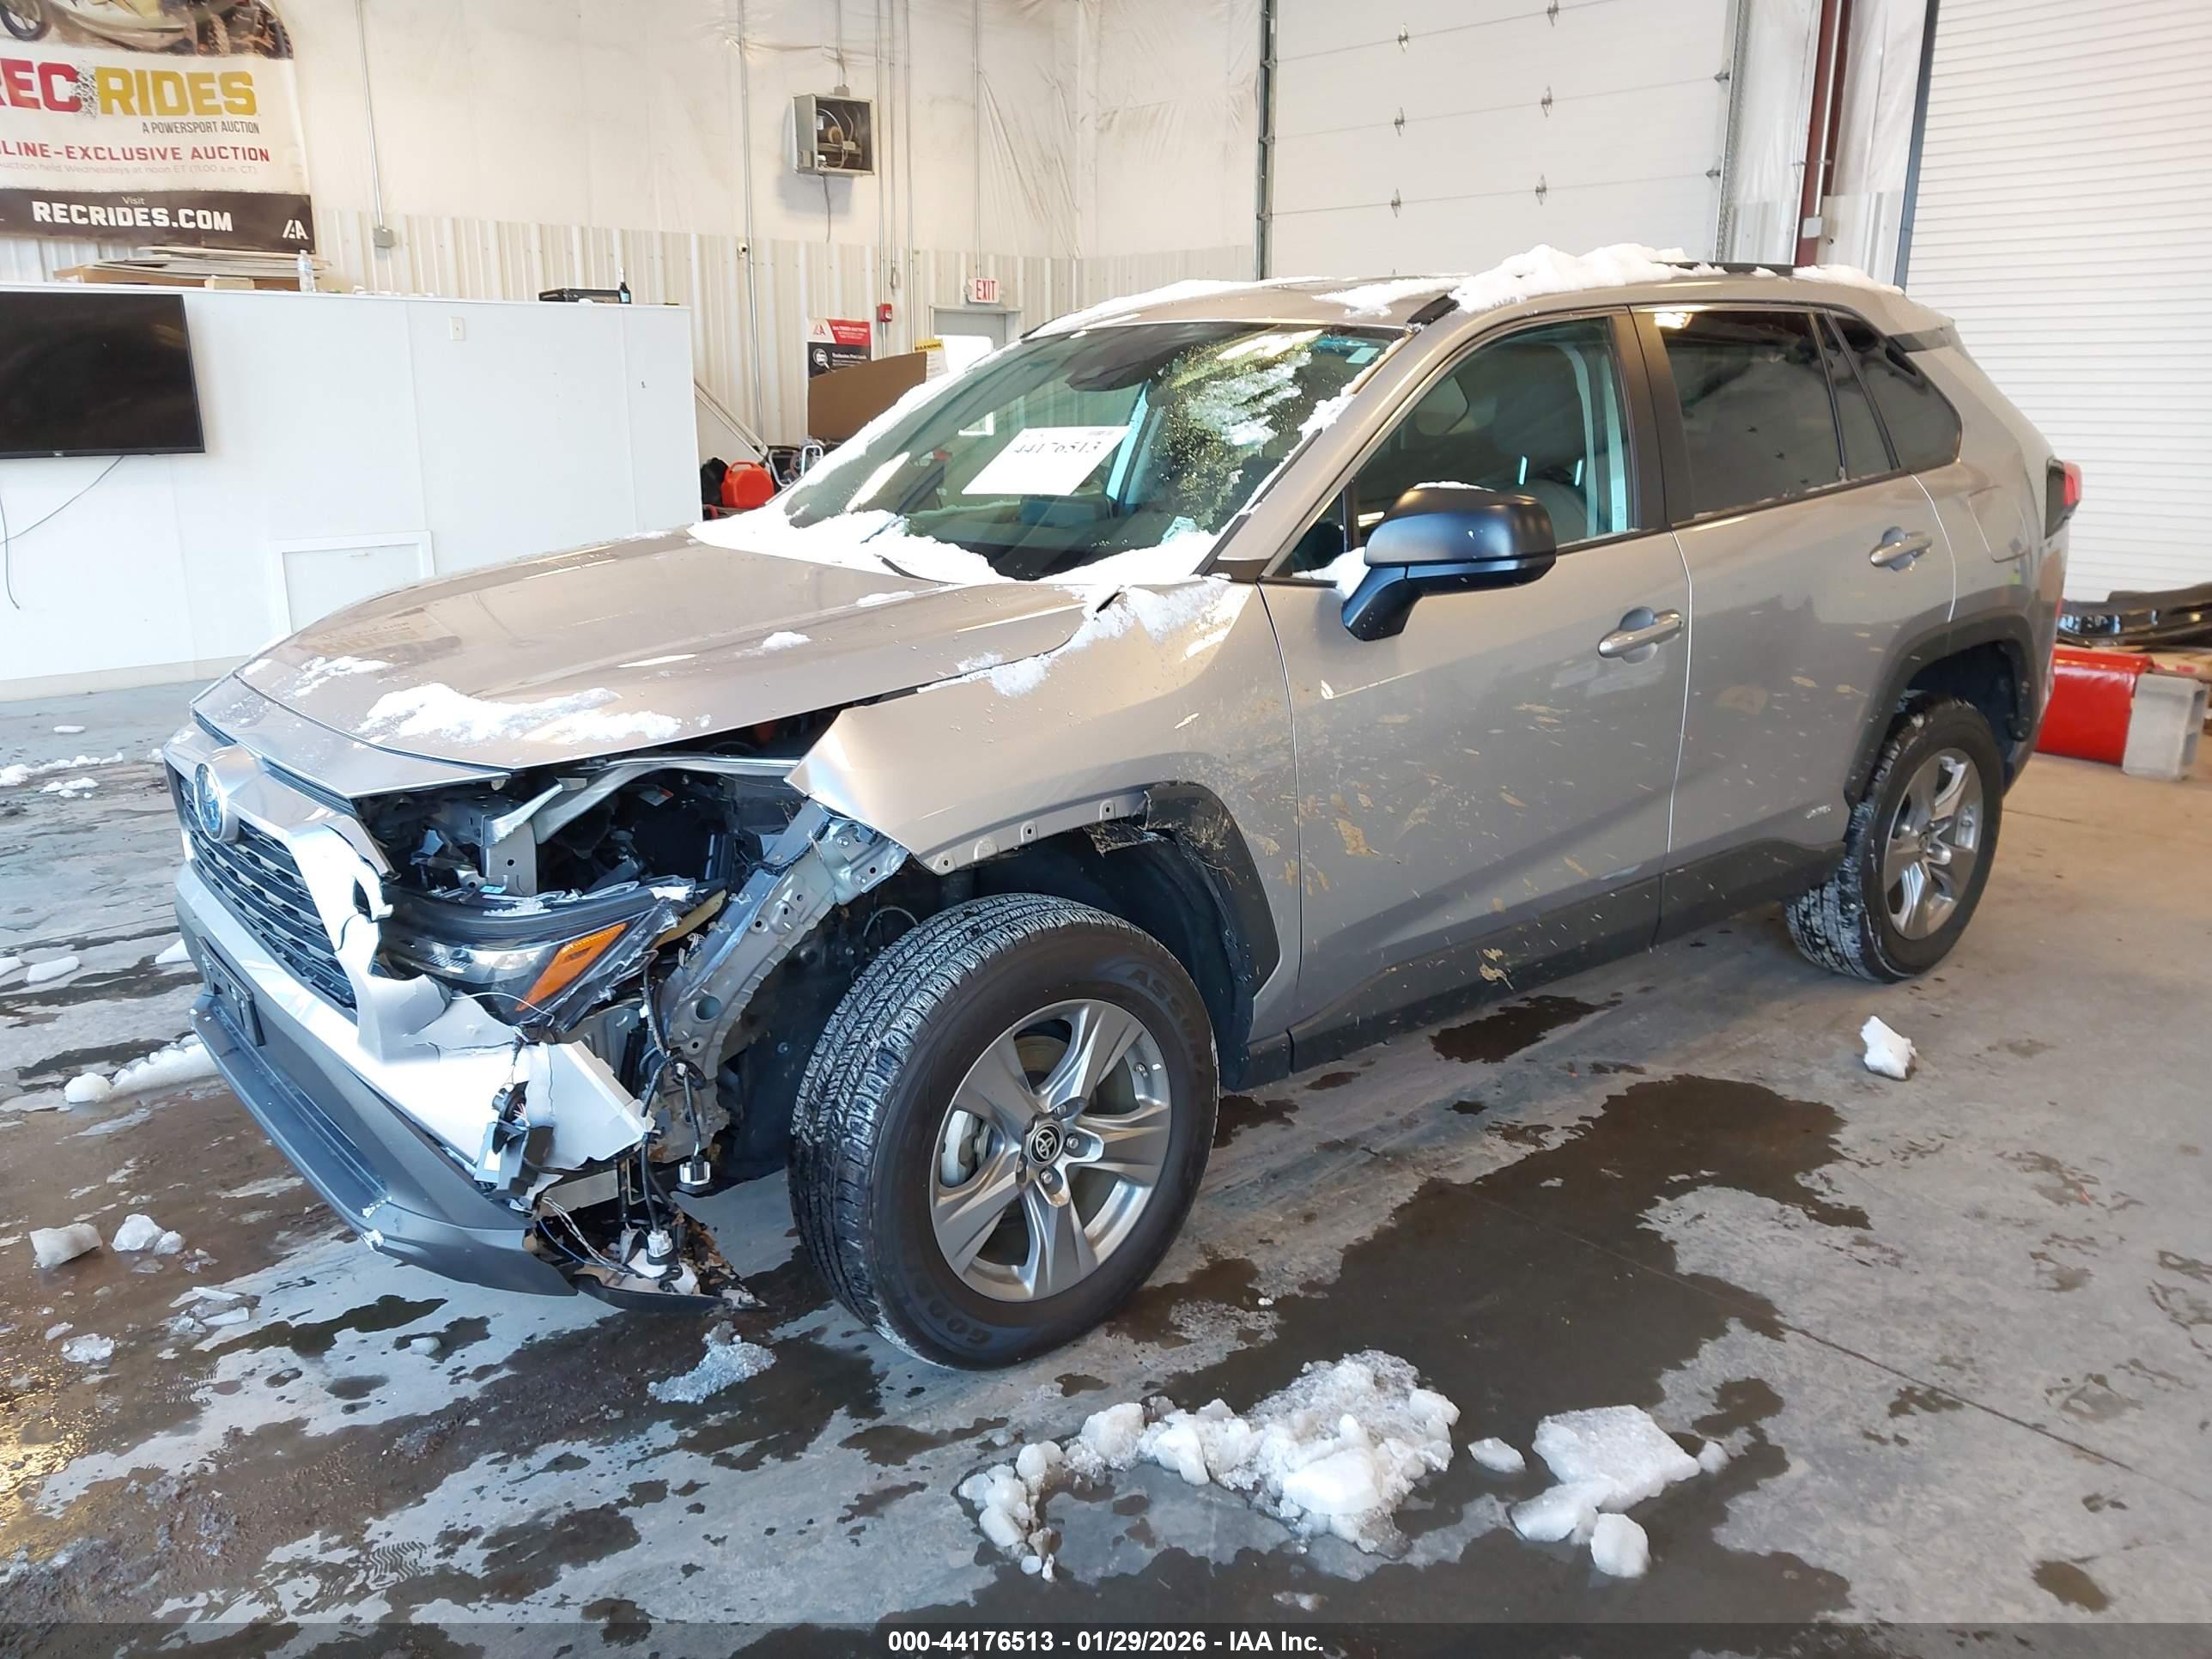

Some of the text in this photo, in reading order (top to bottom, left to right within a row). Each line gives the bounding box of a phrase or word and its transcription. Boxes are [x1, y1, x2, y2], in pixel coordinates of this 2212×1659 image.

[0, 58, 258, 117] EC RIDES
[143, 122, 260, 134] A POWERSPORT AUCTION
[0, 140, 270, 161] LINE-EXCLUSIVE AUCTION
[121, 196, 145, 205] Visit
[32, 201, 233, 232] RECRIDES.COM
[975, 279, 996, 301] EXIT
